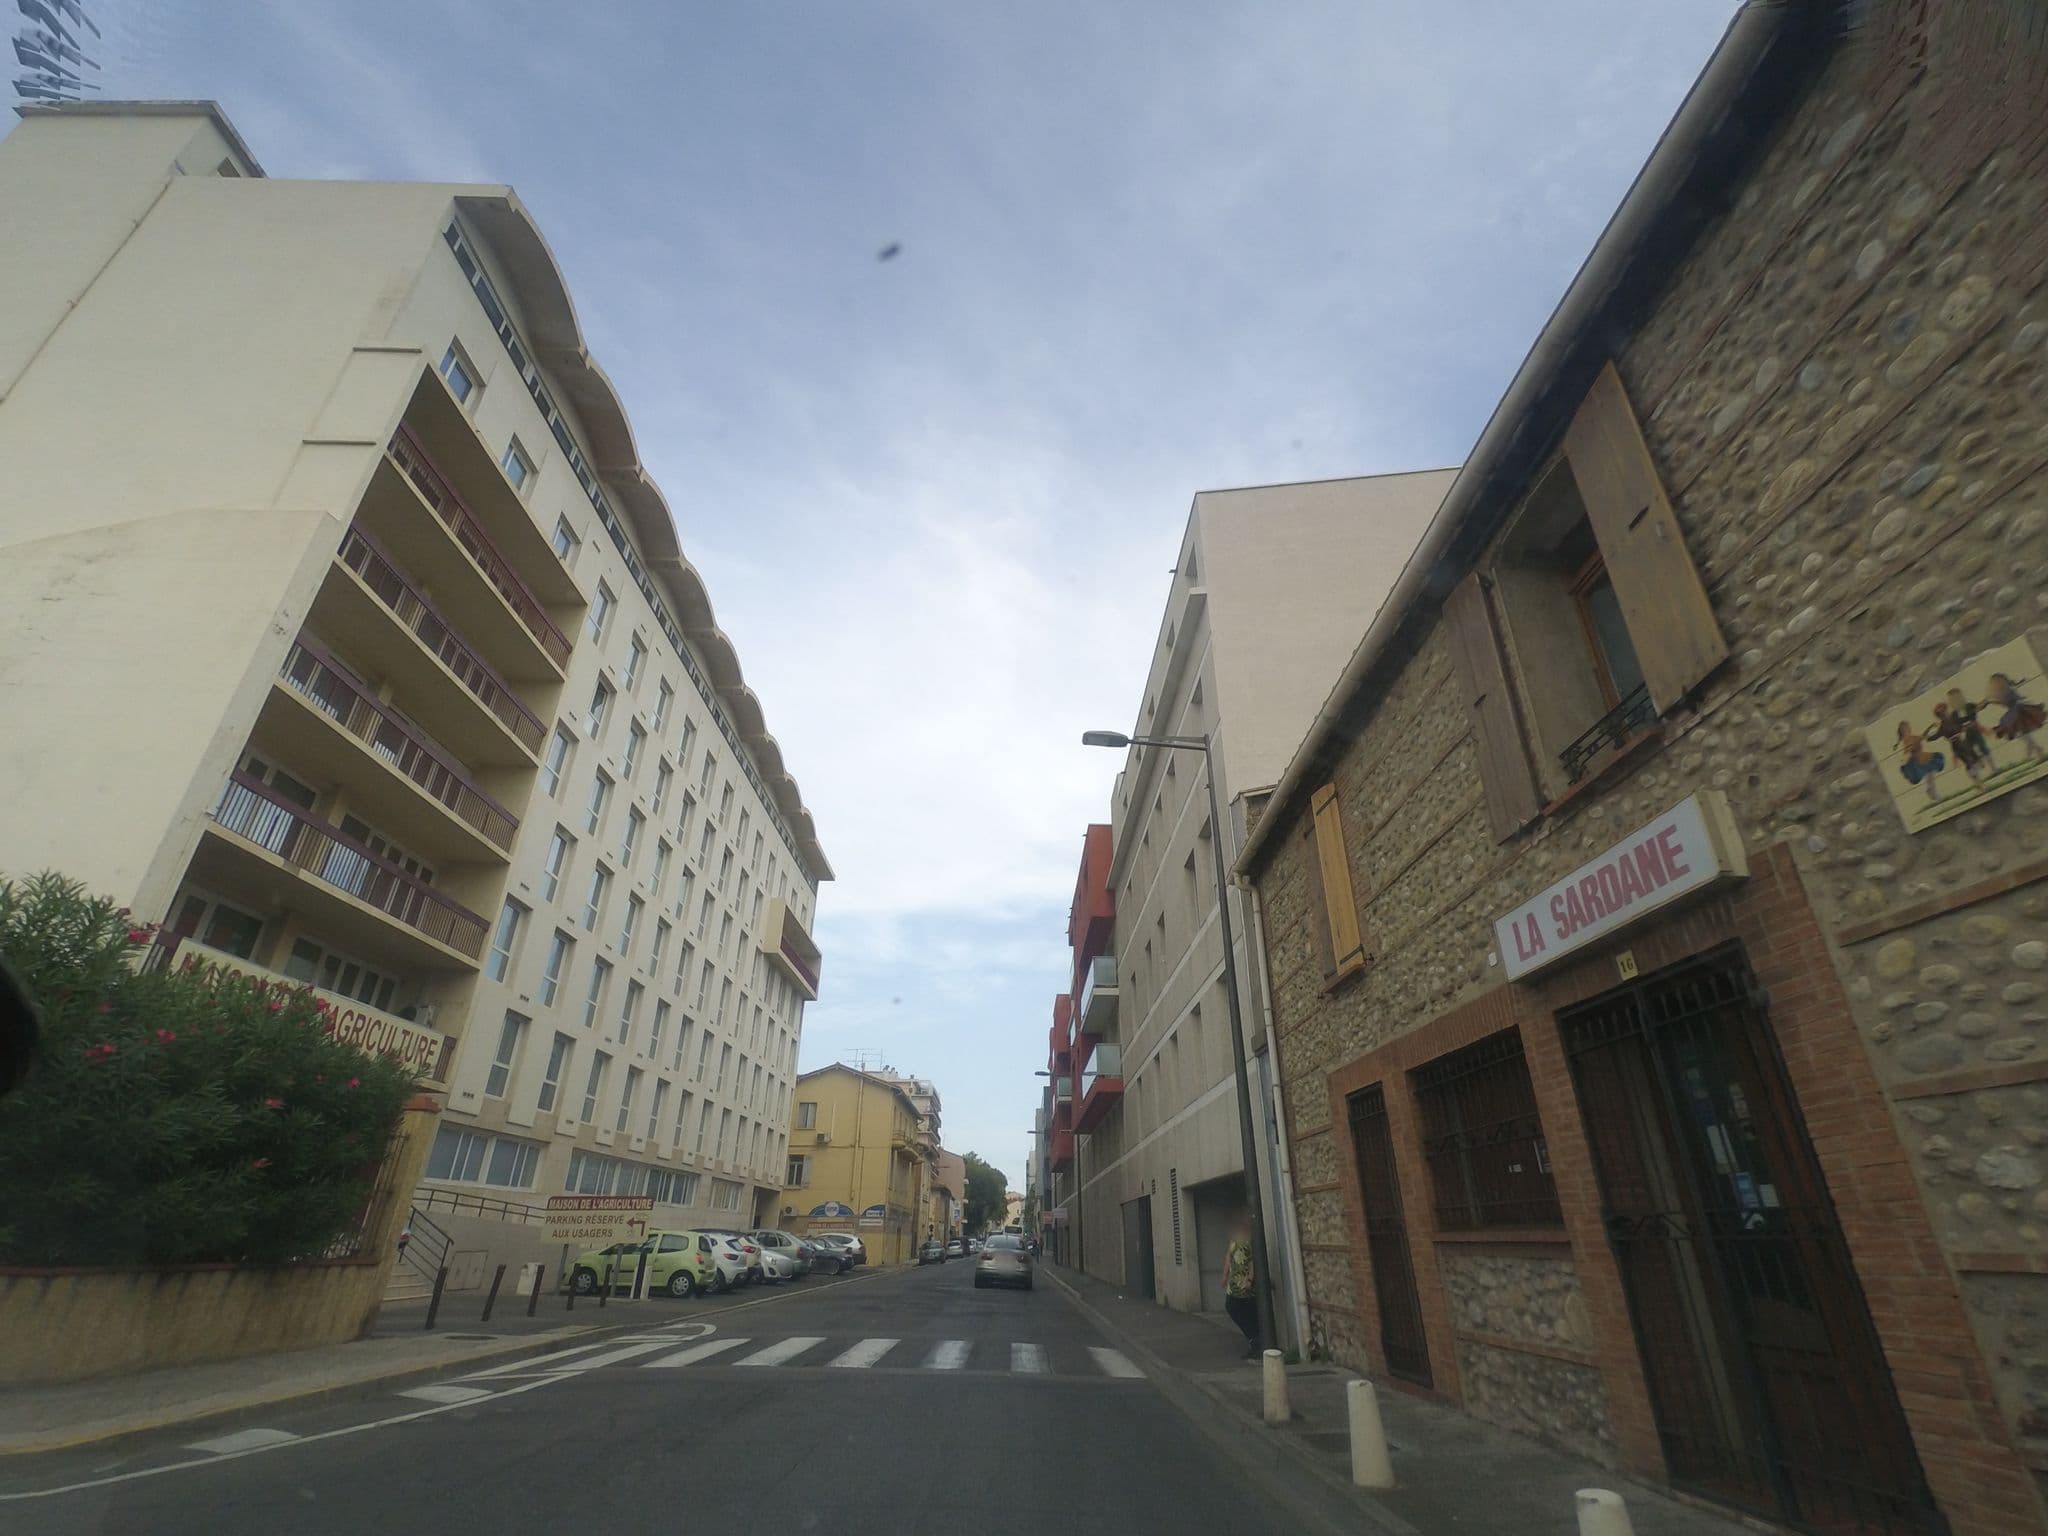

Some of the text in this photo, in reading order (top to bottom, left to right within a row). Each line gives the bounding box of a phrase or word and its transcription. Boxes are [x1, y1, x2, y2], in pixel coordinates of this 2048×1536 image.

[1511, 824, 1691, 962] LA SARDANE
[549, 1199, 652, 1210] MAISON DE L'AGRICULTURE
[545, 1215, 583, 1225] PARKING
[552, 1228, 613, 1238] AUX USAGERS
